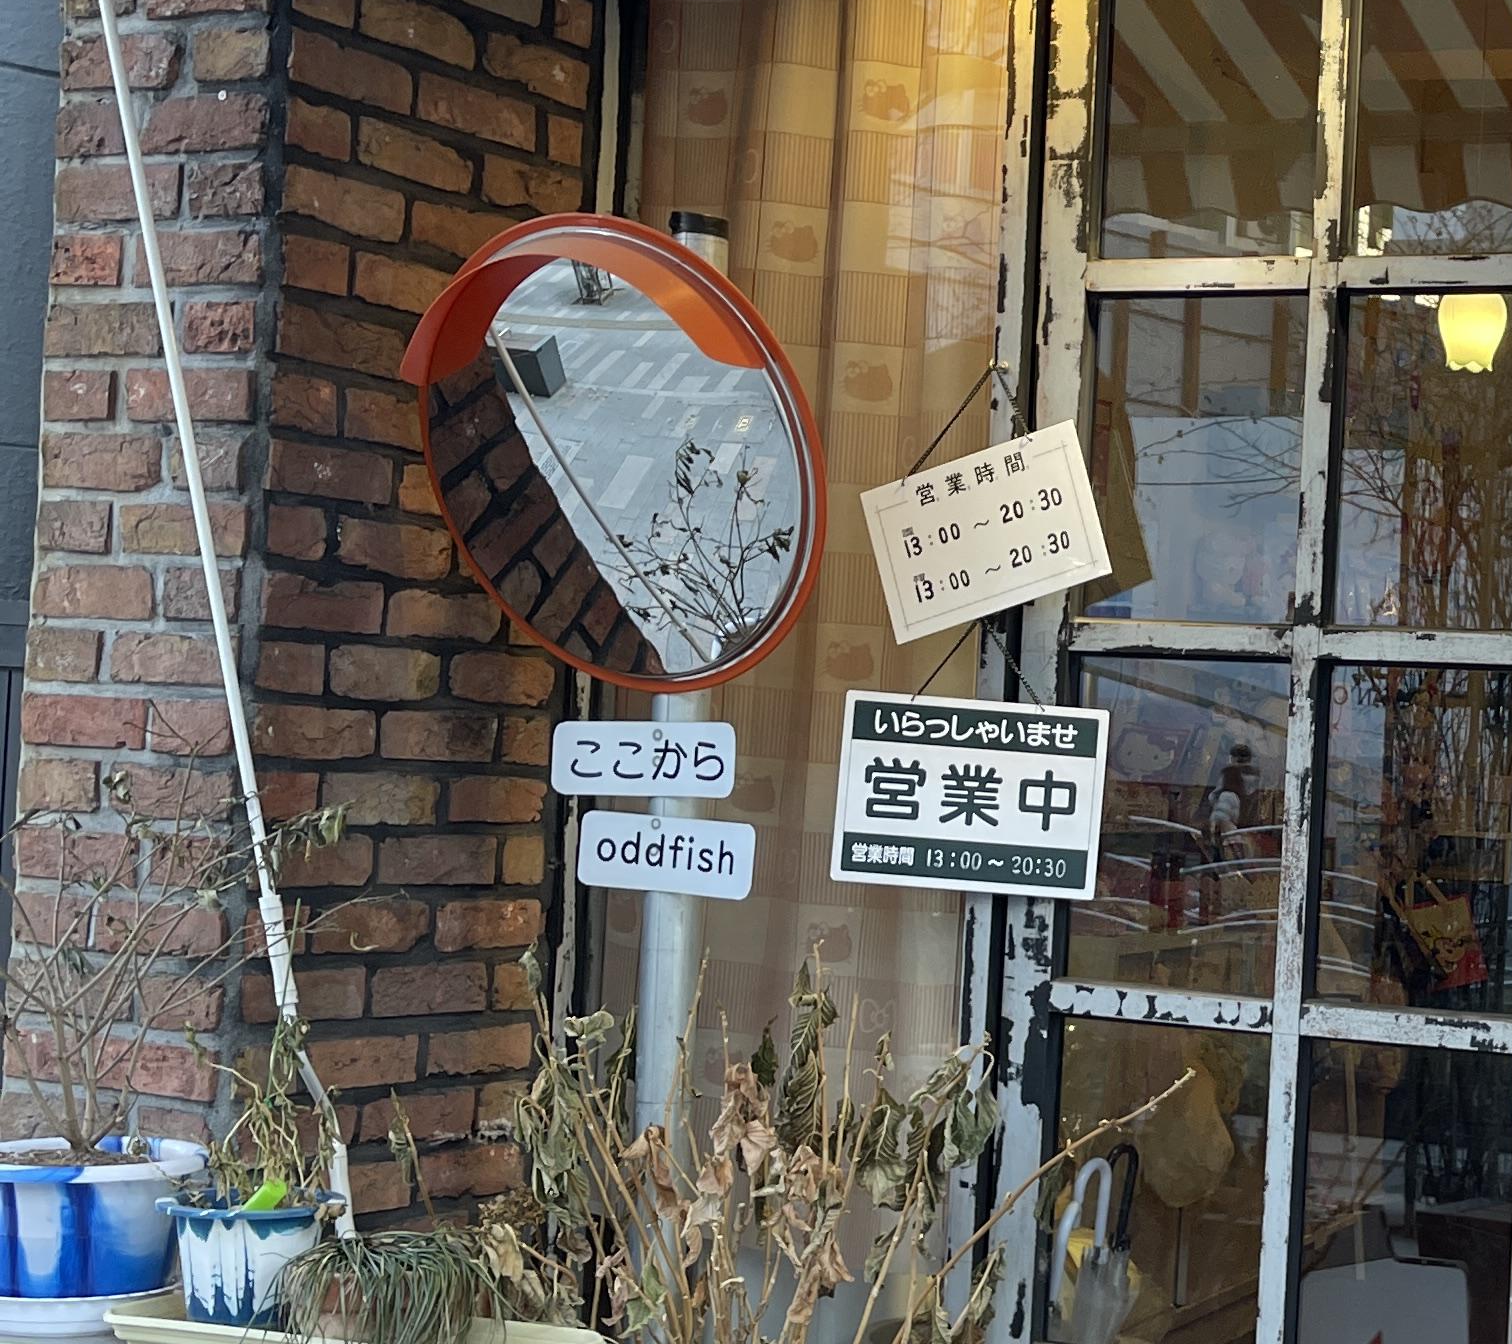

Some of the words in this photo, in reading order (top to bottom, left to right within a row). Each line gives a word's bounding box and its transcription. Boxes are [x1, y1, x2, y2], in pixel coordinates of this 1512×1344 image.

[916, 452, 1026, 506] 営業時間
[904, 522, 961, 559] 13:00
[1000, 487, 1063, 524] 20:30
[915, 568, 971, 603] 13:00
[1009, 530, 1070, 568] 20:30
[874, 709, 1079, 750] いらっしゃいませ
[571, 739, 725, 781] ここから
[865, 756, 1078, 832] 営業中
[597, 831, 735, 875] oddfish
[851, 842, 915, 866] 営業時間
[926, 848, 983, 871] 13:00
[1012, 855, 1067, 879] 20:30
